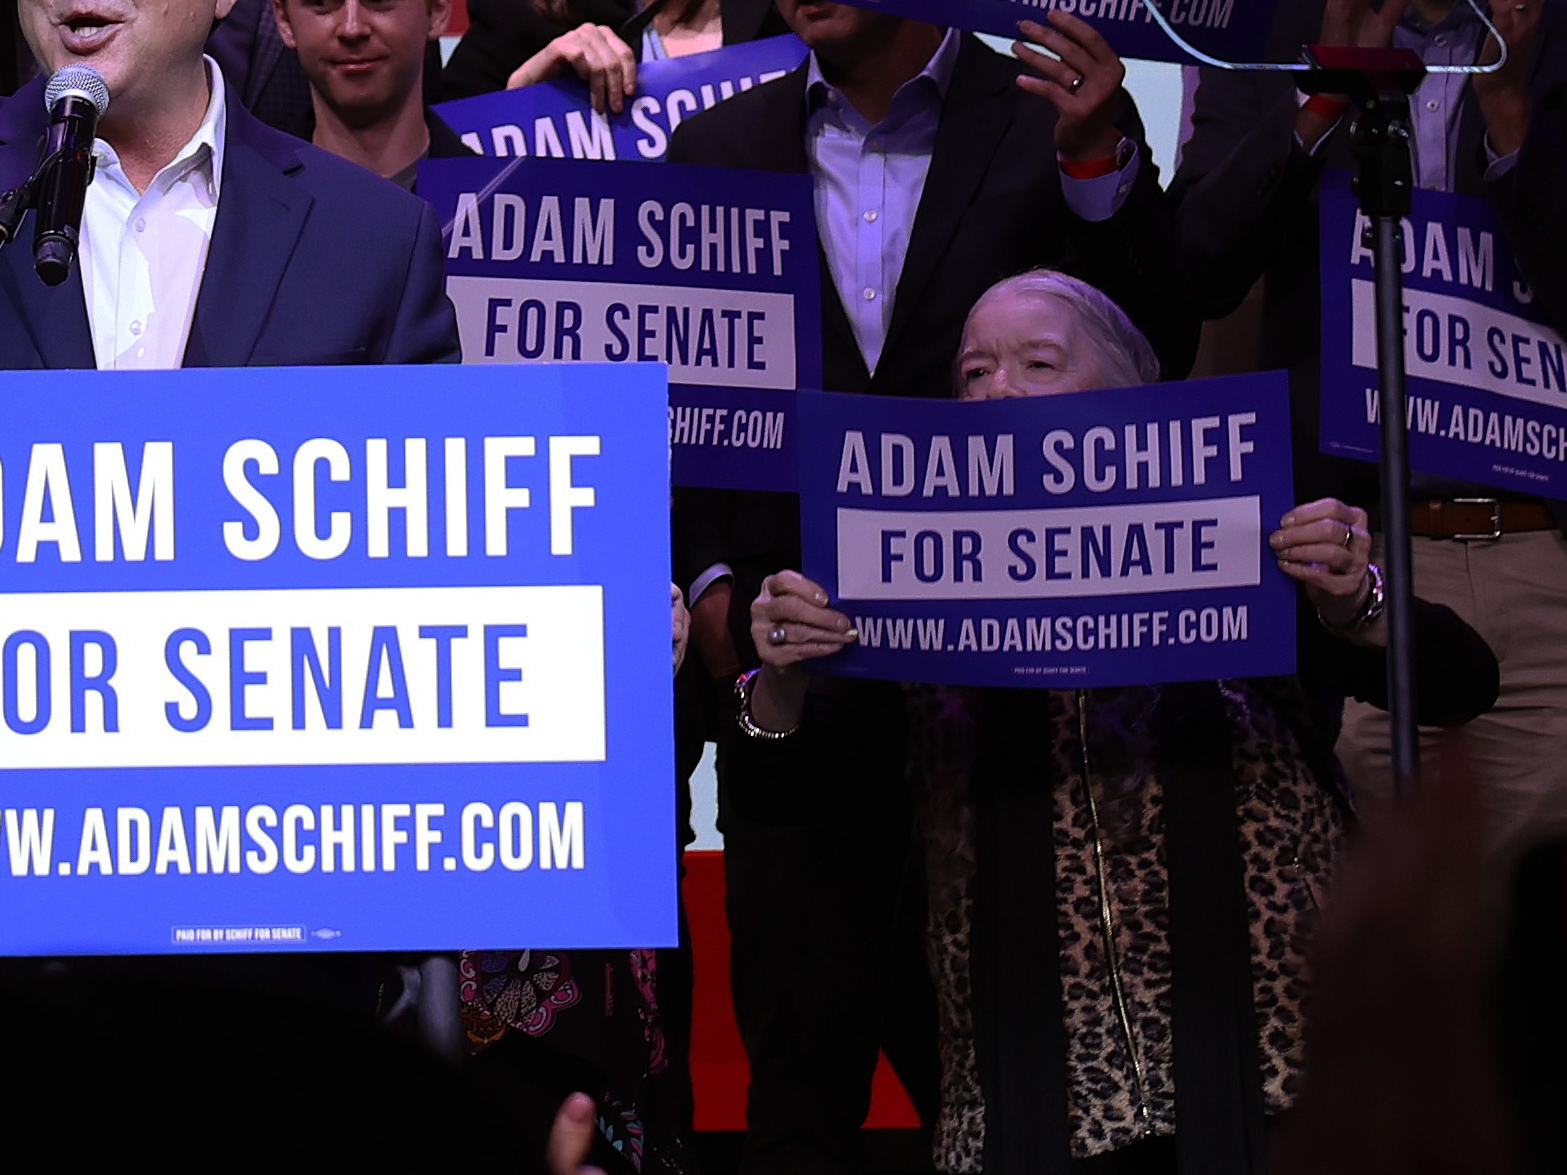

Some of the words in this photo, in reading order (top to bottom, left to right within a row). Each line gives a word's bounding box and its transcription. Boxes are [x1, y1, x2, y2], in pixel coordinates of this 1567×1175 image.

[461, 110, 616, 161] DAM
[447, 192, 615, 265] ADAM
[637, 200, 791, 276] SCHIFF
[484, 297, 582, 361] FOR
[604, 302, 767, 371] SENATE
[1402, 306, 1471, 370] OR
[836, 431, 1014, 497] ADAM
[1042, 412, 1257, 494] SCHIFF
[221, 435, 602, 562] SCHIFF
[881, 530, 982, 583] FOR
[1007, 519, 1218, 582] SENATE
[855, 605, 1248, 653] WWW.ADAMSCHIFF.COM
[164, 623, 529, 733] SENATE
[176, 929, 195, 941] PAID
[196, 929, 211, 941] FOR
[213, 928, 225, 941] BY
[225, 928, 253, 941] SCHIFF
[255, 928, 271, 940] FOR
[272, 927, 302, 940] SENATE
